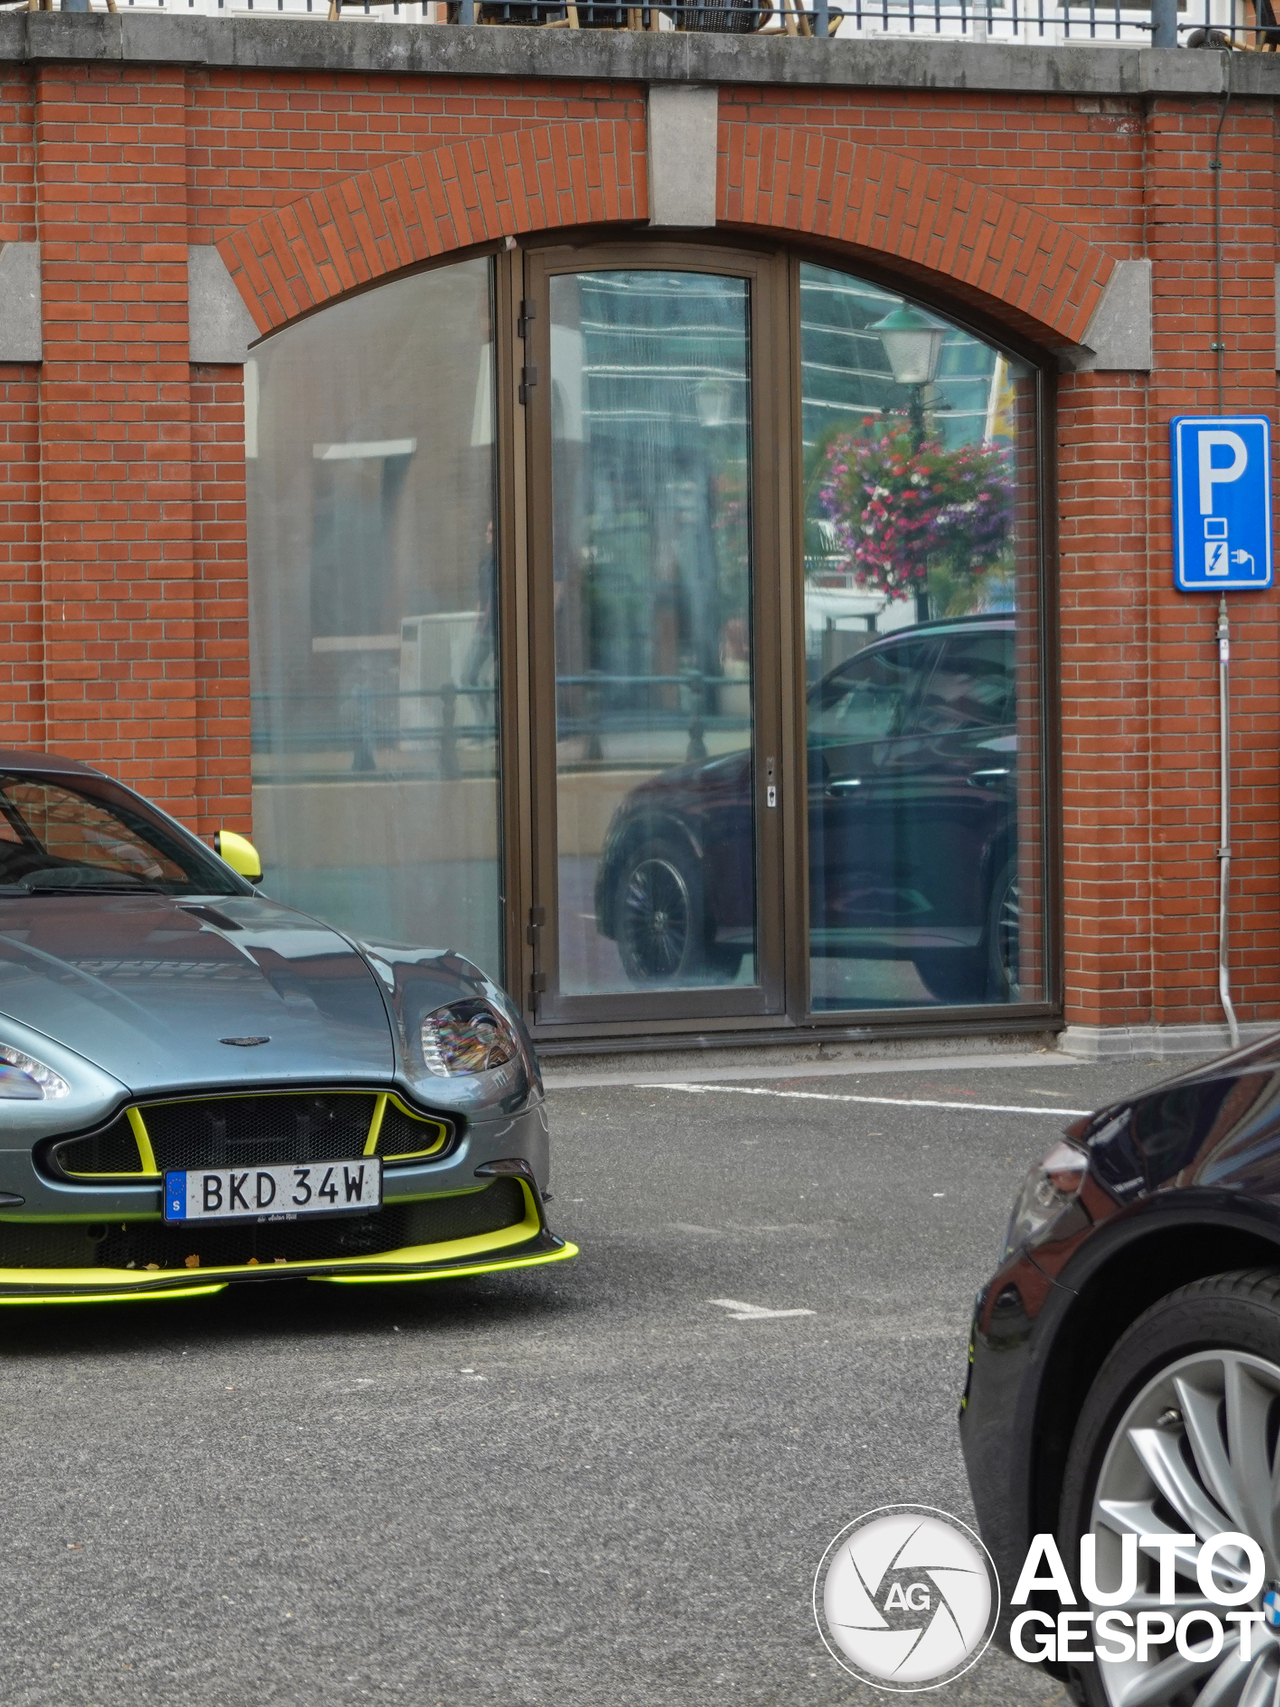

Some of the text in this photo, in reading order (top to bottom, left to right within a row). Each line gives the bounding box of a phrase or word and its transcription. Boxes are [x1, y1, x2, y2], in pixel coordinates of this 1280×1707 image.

[1197, 430, 1248, 515] P
[172, 1200, 180, 1211] S
[202, 1164, 366, 1212] BKD 34W
